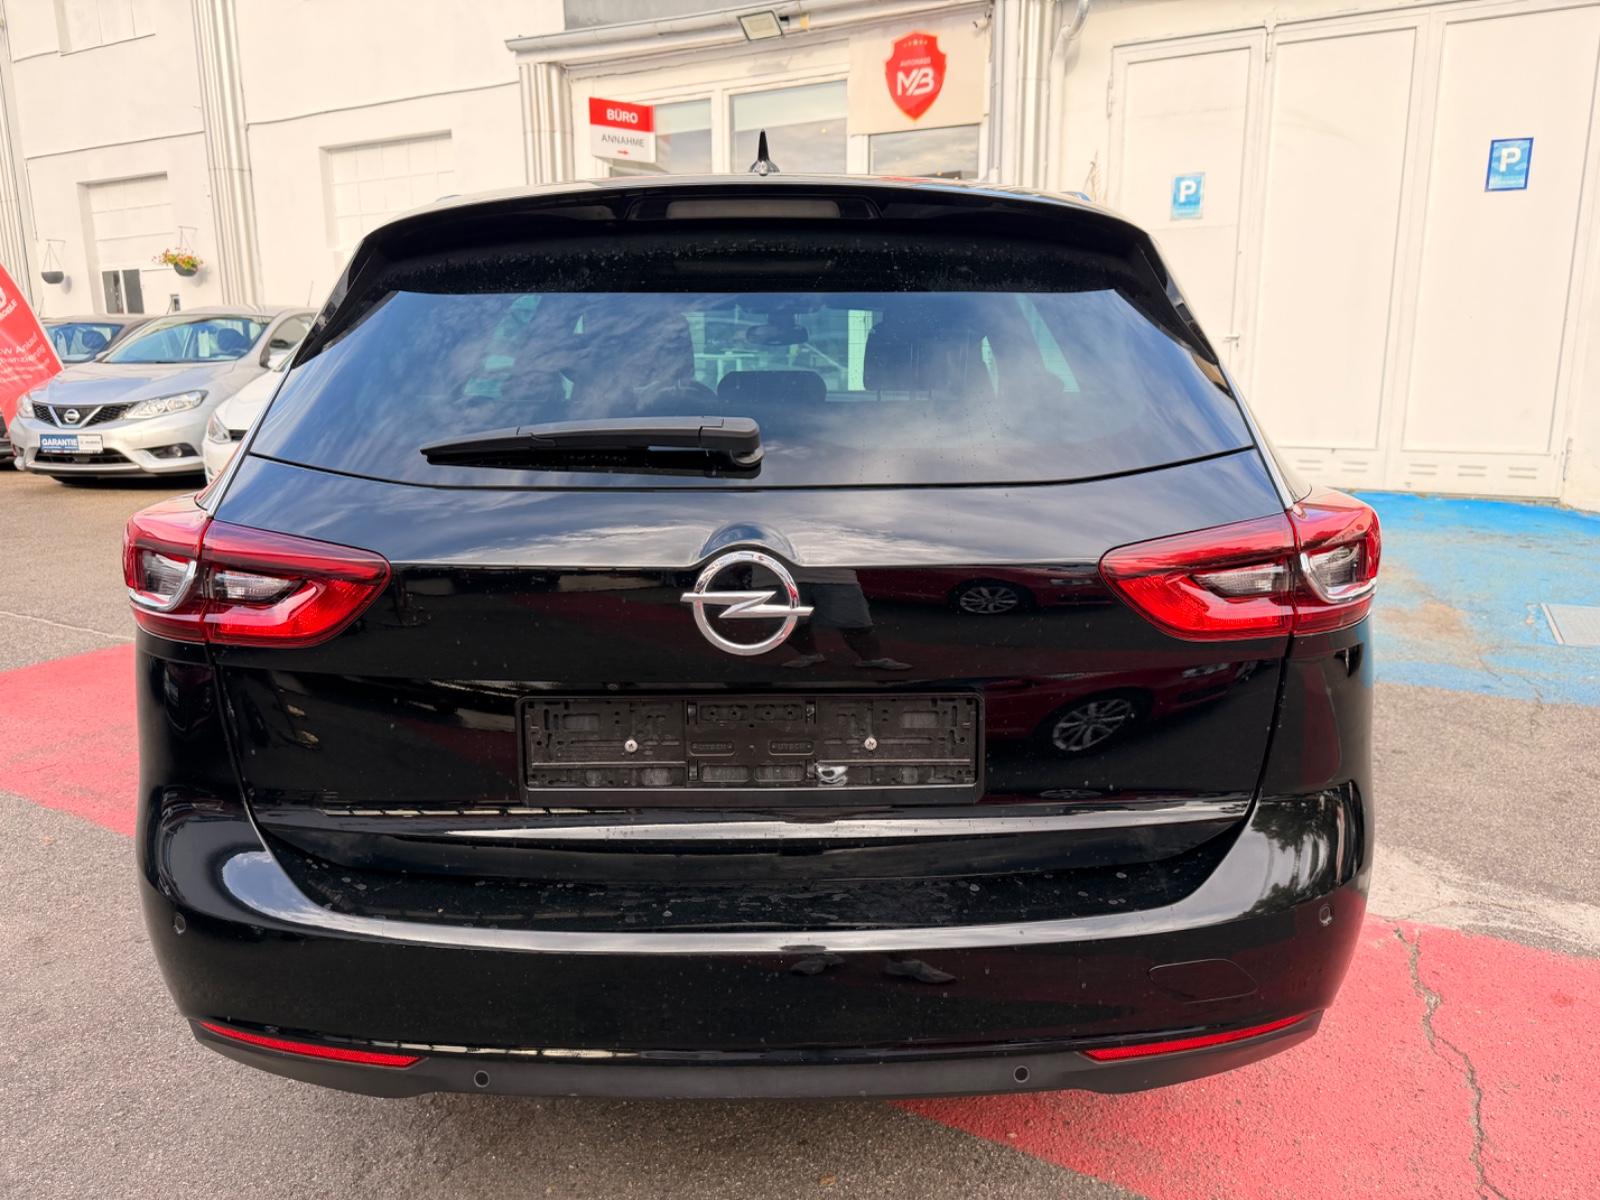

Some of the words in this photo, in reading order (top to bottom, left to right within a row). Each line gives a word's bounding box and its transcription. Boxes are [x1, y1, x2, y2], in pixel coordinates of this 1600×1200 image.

[897, 67, 935, 97] MB
[606, 107, 639, 124] BÜRO
[601, 133, 645, 148] ANNAHME
[1499, 147, 1521, 172] P
[1180, 181, 1197, 203] P
